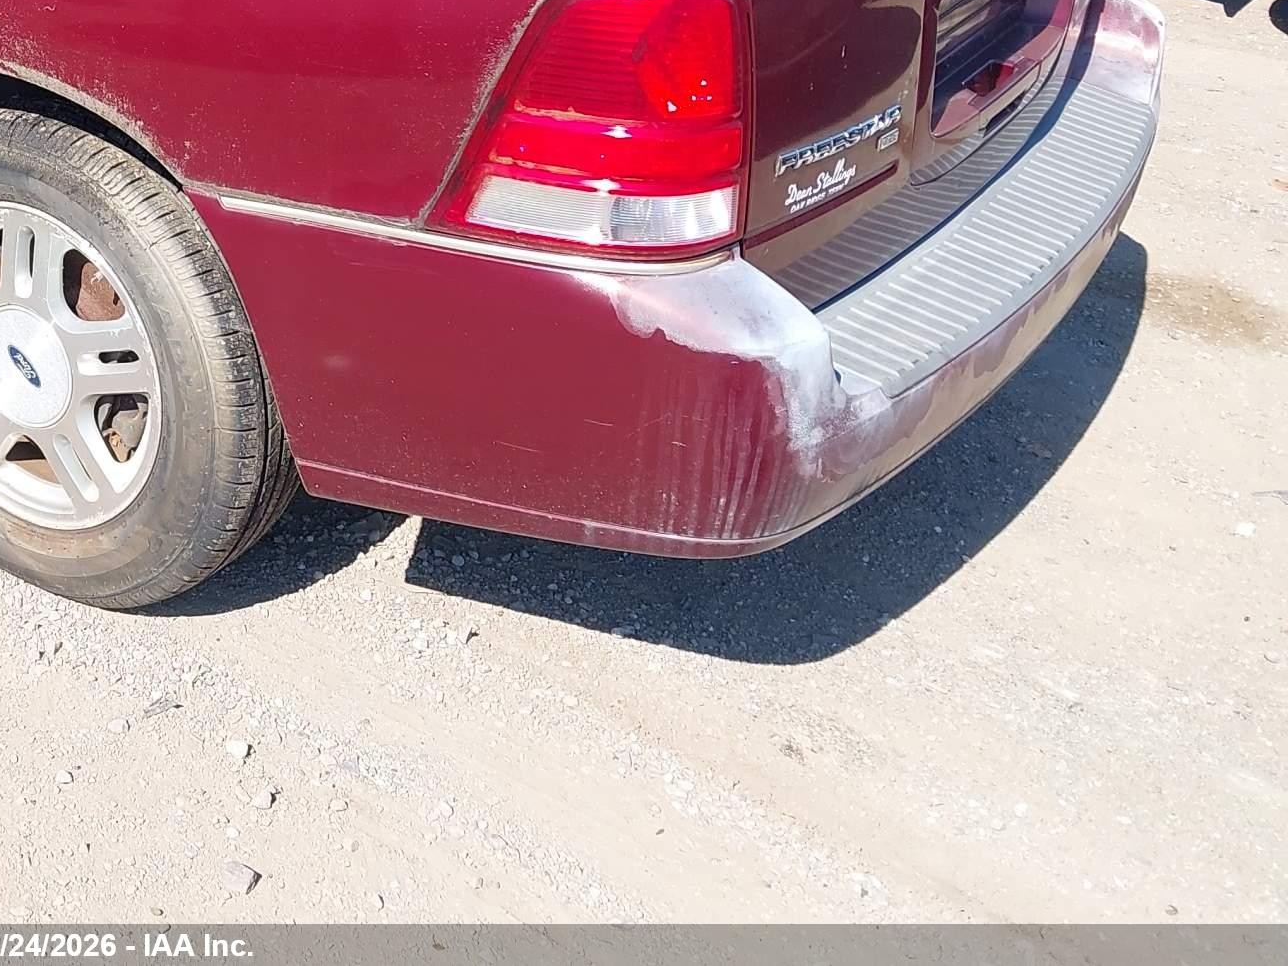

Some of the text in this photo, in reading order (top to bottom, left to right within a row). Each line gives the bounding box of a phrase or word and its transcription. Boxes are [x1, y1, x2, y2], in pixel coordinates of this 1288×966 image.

[775, 105, 902, 177] FREESTAR
[784, 183, 813, 206] Dean
[812, 157, 857, 194] Stallings
